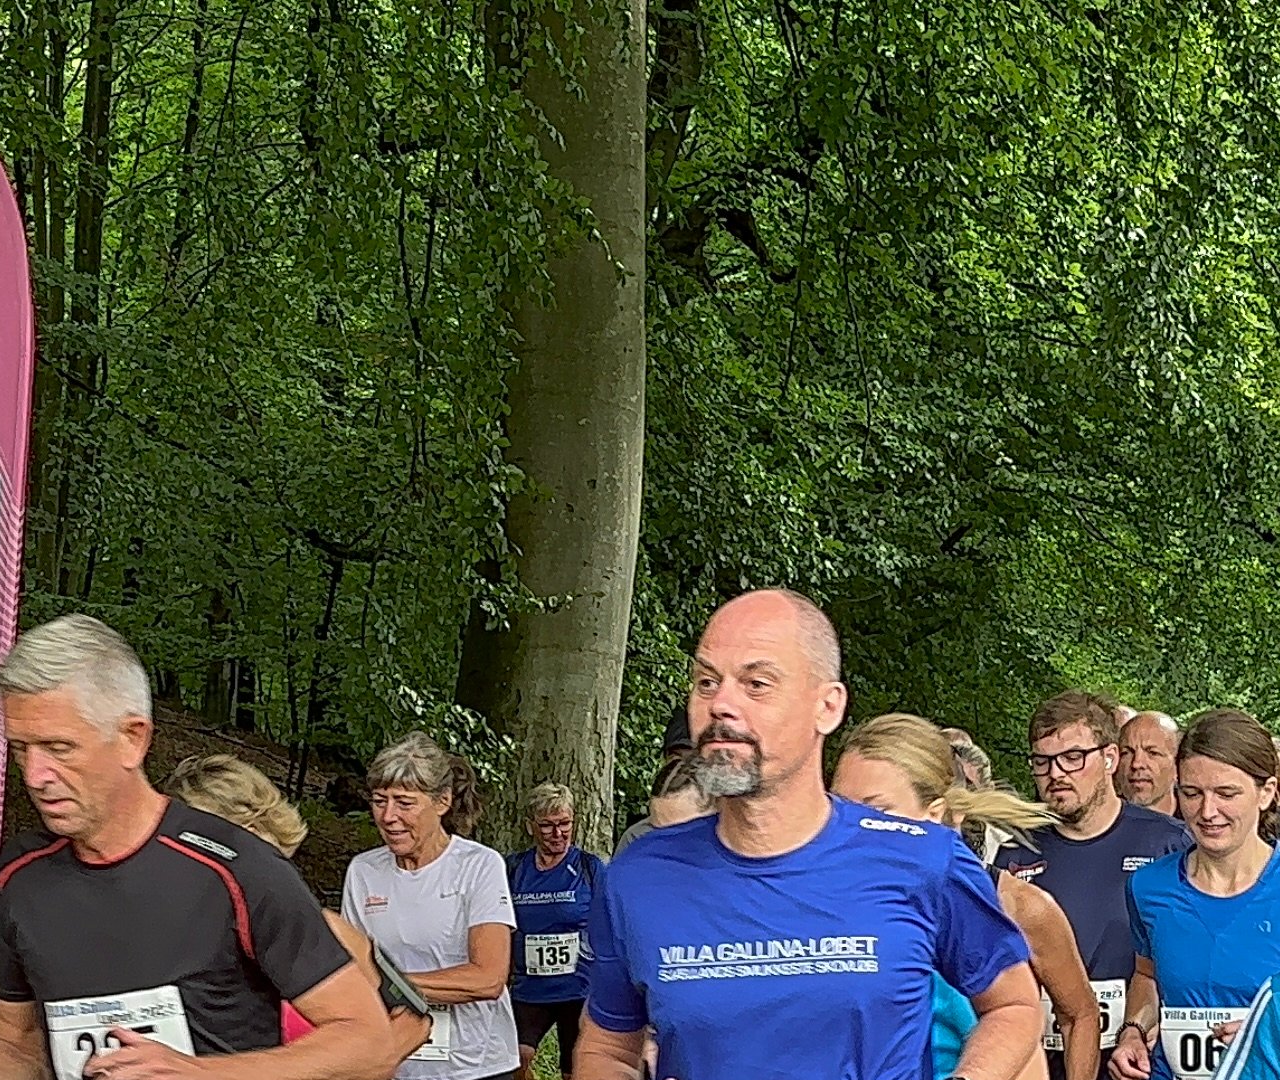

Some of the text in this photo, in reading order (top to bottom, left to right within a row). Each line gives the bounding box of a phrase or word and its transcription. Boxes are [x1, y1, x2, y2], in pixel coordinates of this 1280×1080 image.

[536, 946, 570, 967] 135
[659, 944, 715, 964] VILLA
[1164, 1010, 1231, 1021] Villa Gallina
